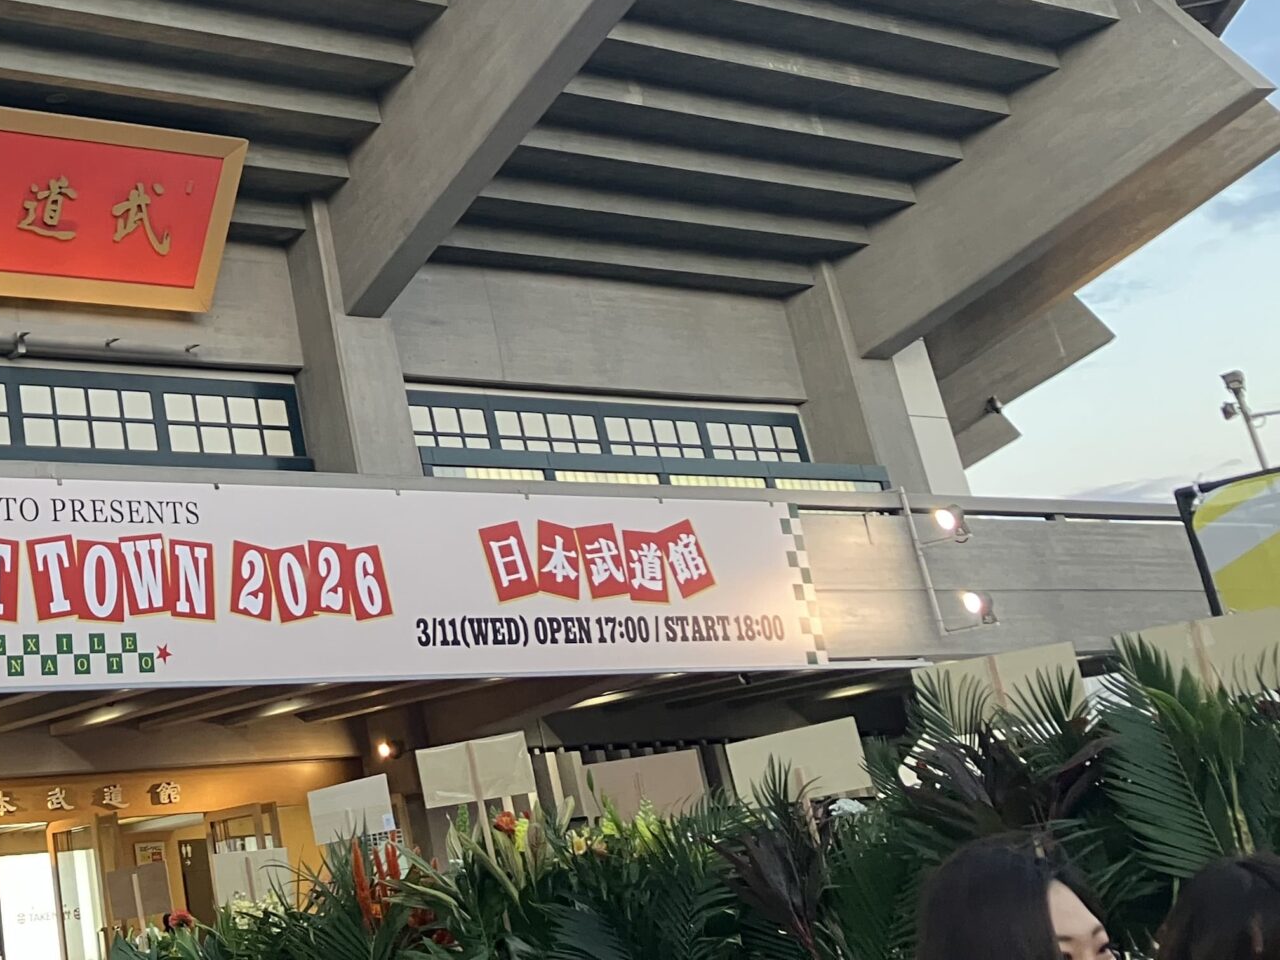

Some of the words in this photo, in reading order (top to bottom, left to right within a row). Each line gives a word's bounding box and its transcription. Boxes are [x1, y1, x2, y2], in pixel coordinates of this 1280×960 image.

[50, 498, 200, 524] PRESENTS
[35, 537, 210, 621] TOWN
[239, 545, 384, 618] 2026
[488, 533, 709, 592] 日本武道館
[416, 615, 529, 648] 3/11(WED)
[534, 616, 592, 645] OPEN
[595, 615, 650, 644] 17:00
[664, 615, 731, 642] START
[733, 614, 785, 642] 18:00
[10, 656, 153, 673] NAOTO
